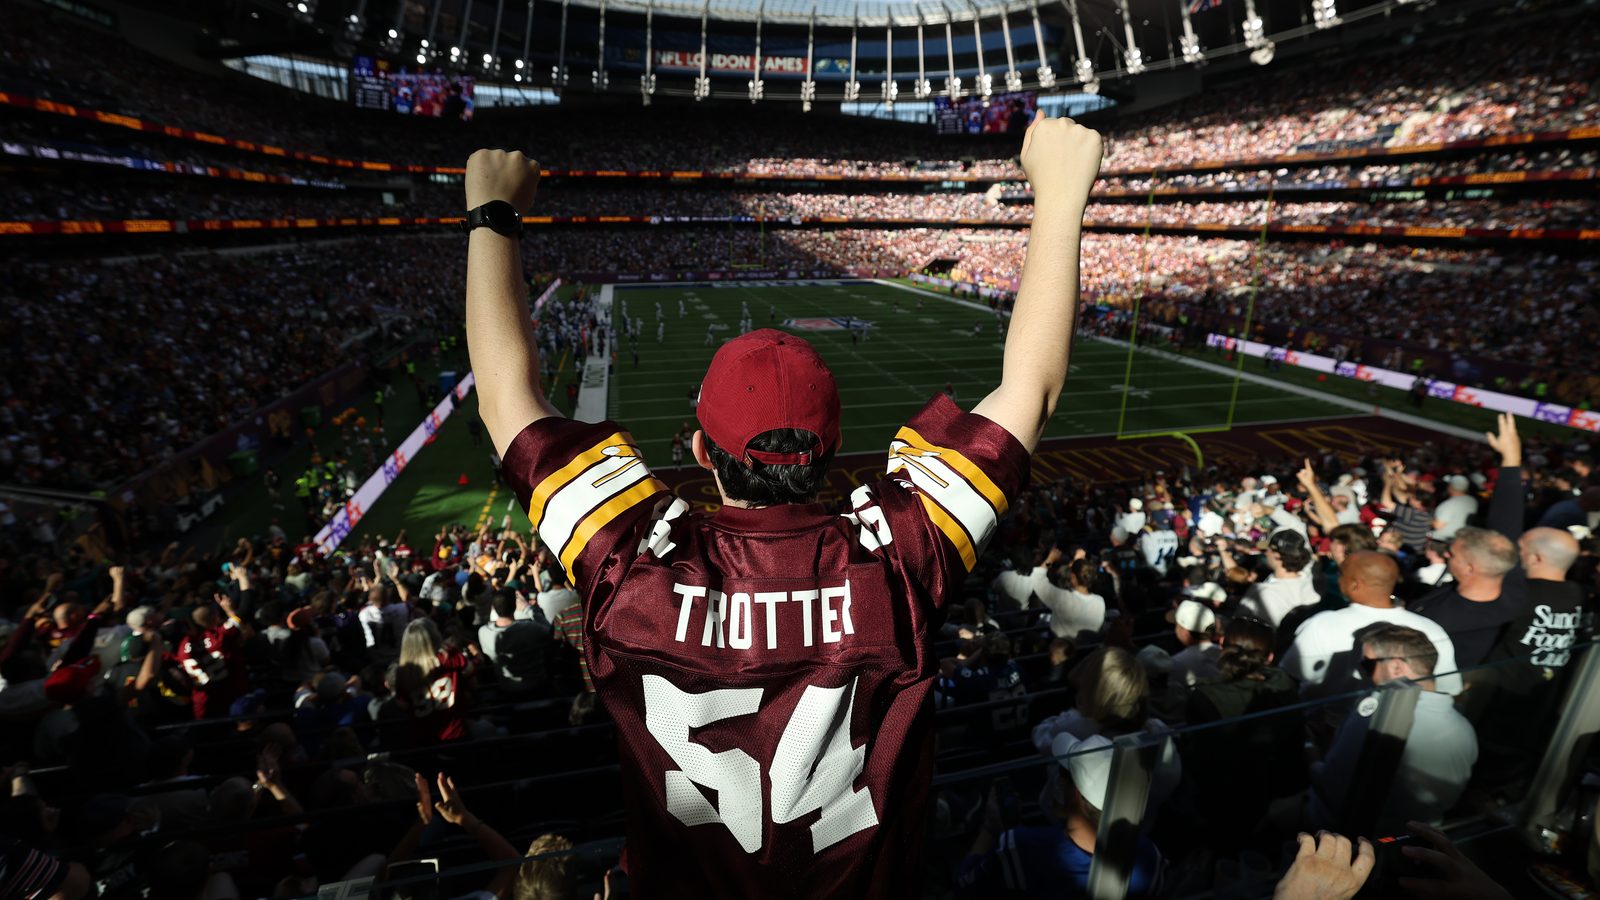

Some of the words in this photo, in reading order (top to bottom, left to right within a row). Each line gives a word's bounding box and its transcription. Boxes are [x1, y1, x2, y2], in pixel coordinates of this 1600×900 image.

[654, 51, 682, 65] NFL
[687, 53, 750, 69] LONDON
[1532, 604, 1594, 632] Sund
[641, 673, 880, 855] 54
